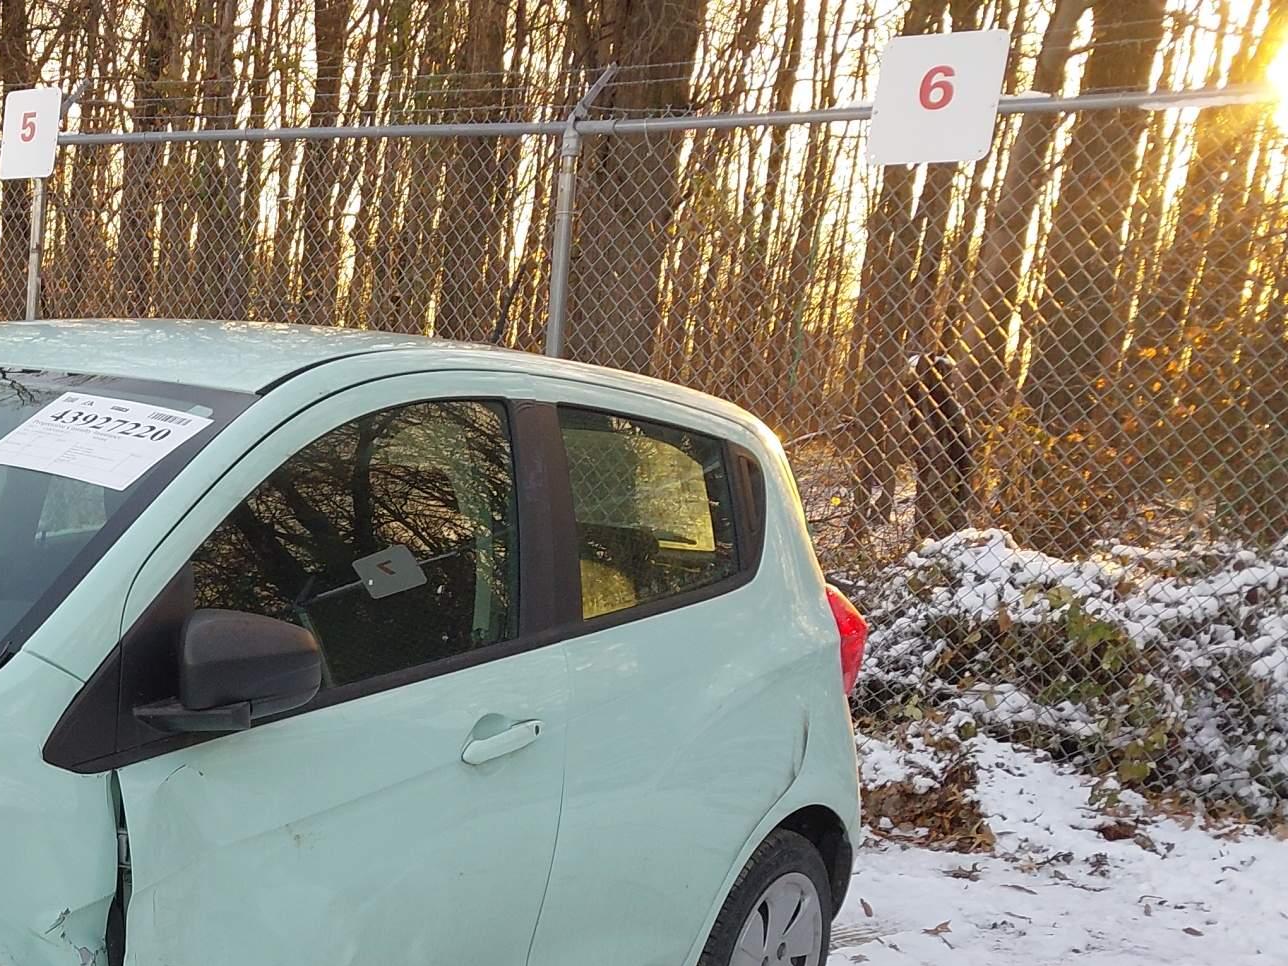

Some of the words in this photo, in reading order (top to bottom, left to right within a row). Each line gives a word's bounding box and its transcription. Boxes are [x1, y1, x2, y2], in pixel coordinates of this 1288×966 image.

[918, 65, 955, 110] 6
[20, 111, 37, 142] 5
[49, 409, 172, 442] 43927220
